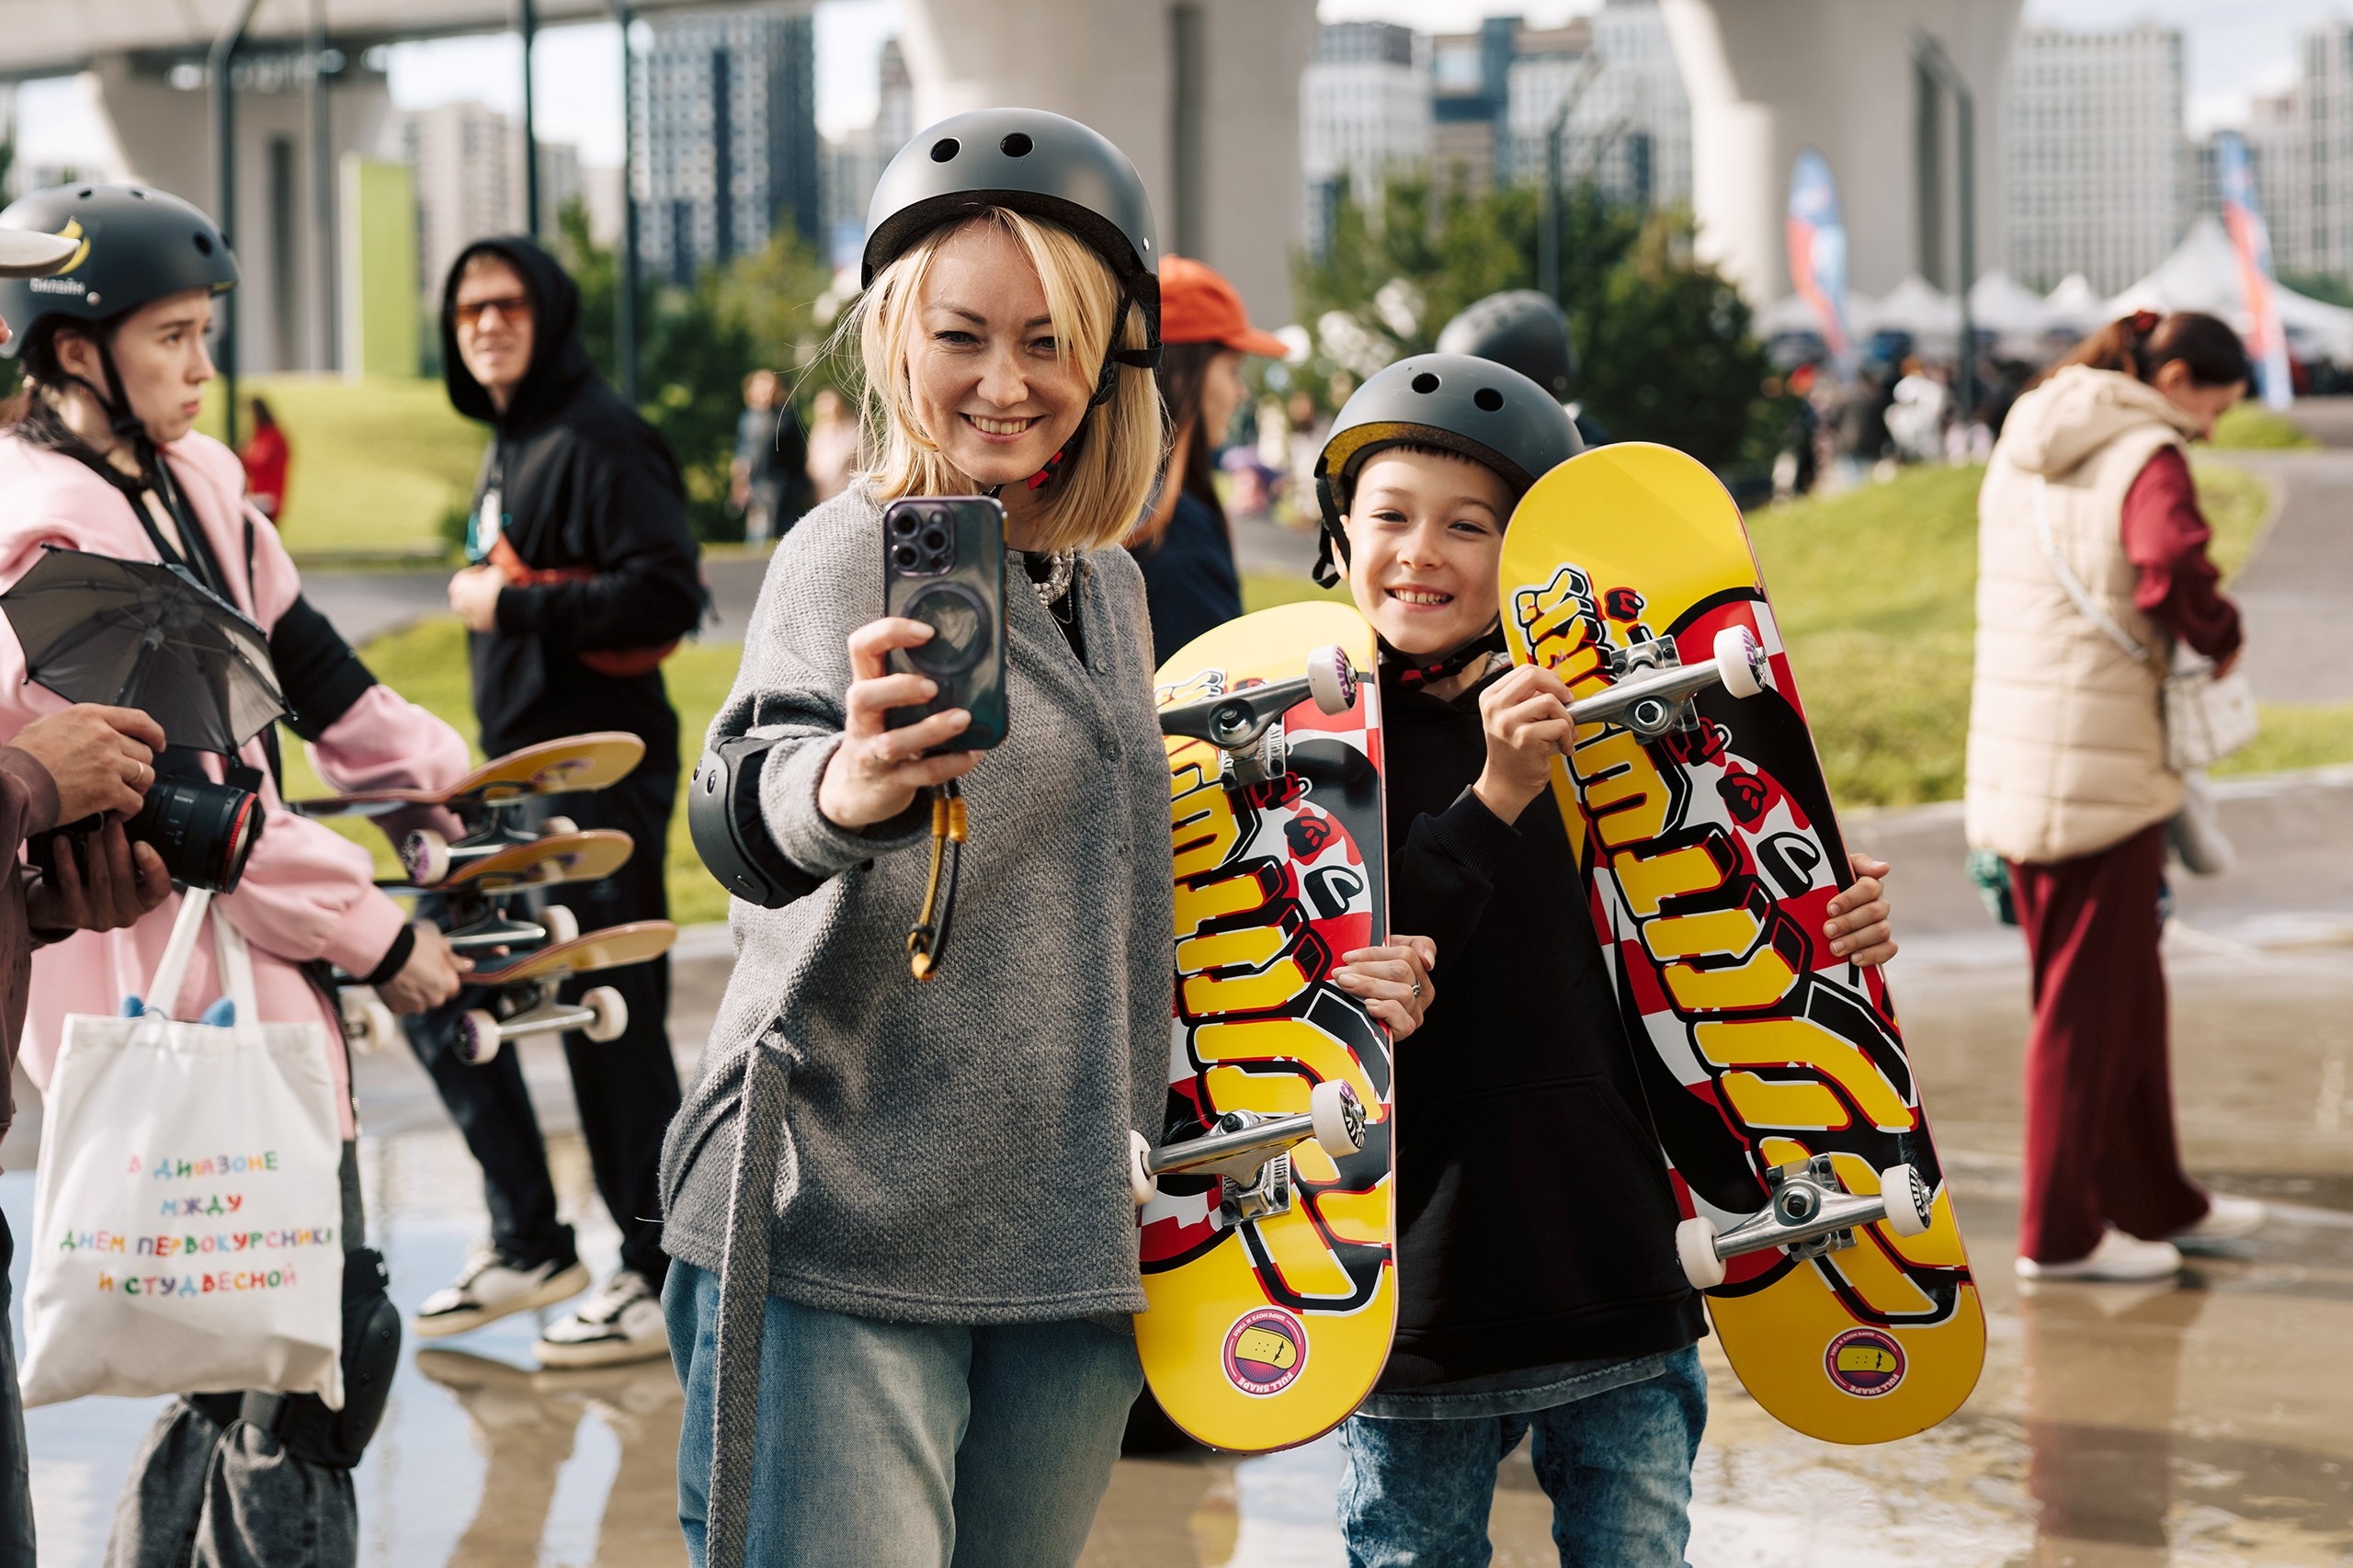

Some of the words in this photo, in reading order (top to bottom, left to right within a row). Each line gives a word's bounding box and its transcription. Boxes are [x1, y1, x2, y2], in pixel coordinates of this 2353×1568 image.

[128, 1154, 142, 1174] В
[160, 1193, 243, 1216] МЖДУ
[98, 1270, 114, 1291] И
[125, 1263, 297, 1298] СТУДВЕСНОЙ
[1237, 1377, 1270, 1392] SHAPE
[1270, 1371, 1295, 1390] FULL
[1848, 1385, 1881, 1395] SHAPE
[1881, 1373, 1900, 1391] FULL
